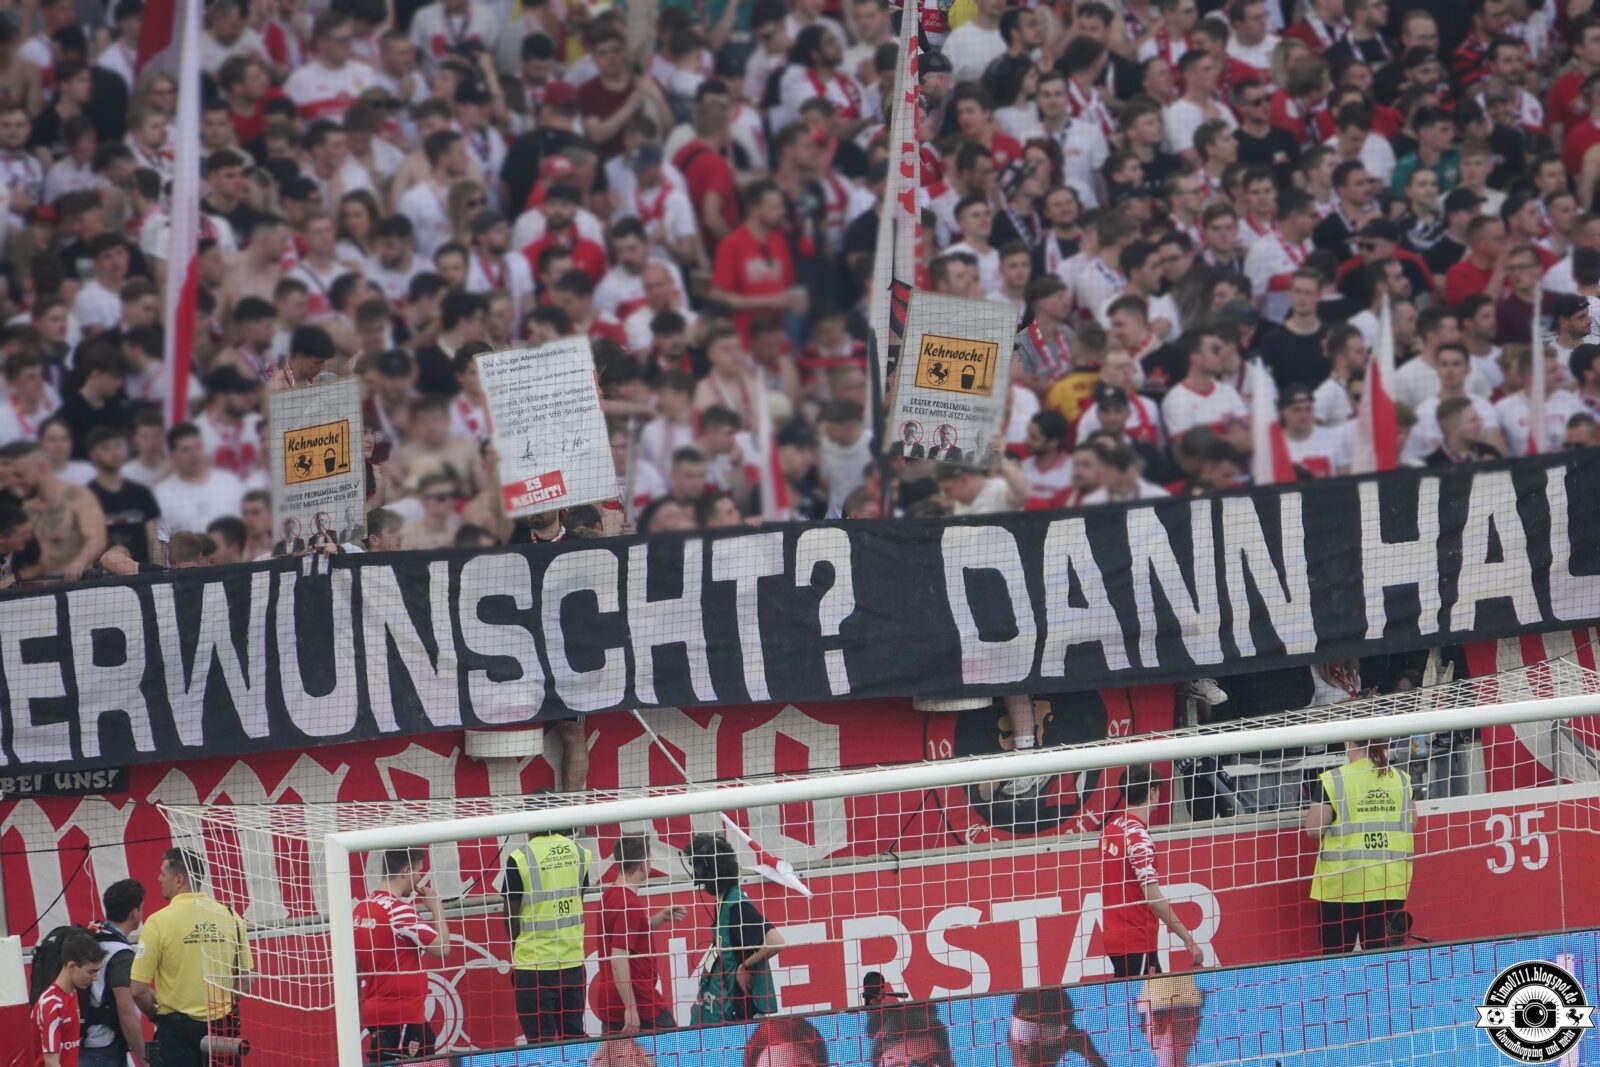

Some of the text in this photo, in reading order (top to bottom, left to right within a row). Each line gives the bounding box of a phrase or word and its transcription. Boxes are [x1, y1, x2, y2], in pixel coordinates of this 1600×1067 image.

[924, 342, 985, 363] Kehrwoche
[533, 414, 546, 422] des
[548, 410, 563, 419] VfB
[287, 431, 340, 452] Kehrwoche
[524, 477, 542, 491] ES
[0, 526, 856, 766] ERWÜNSCHT?
[941, 492, 1317, 684] DANN
[0, 769, 120, 793] BEI UNS!
[549, 845, 571, 856] SDS
[1485, 809, 1549, 874] 35
[514, 883, 1222, 1048] KERSTAR
